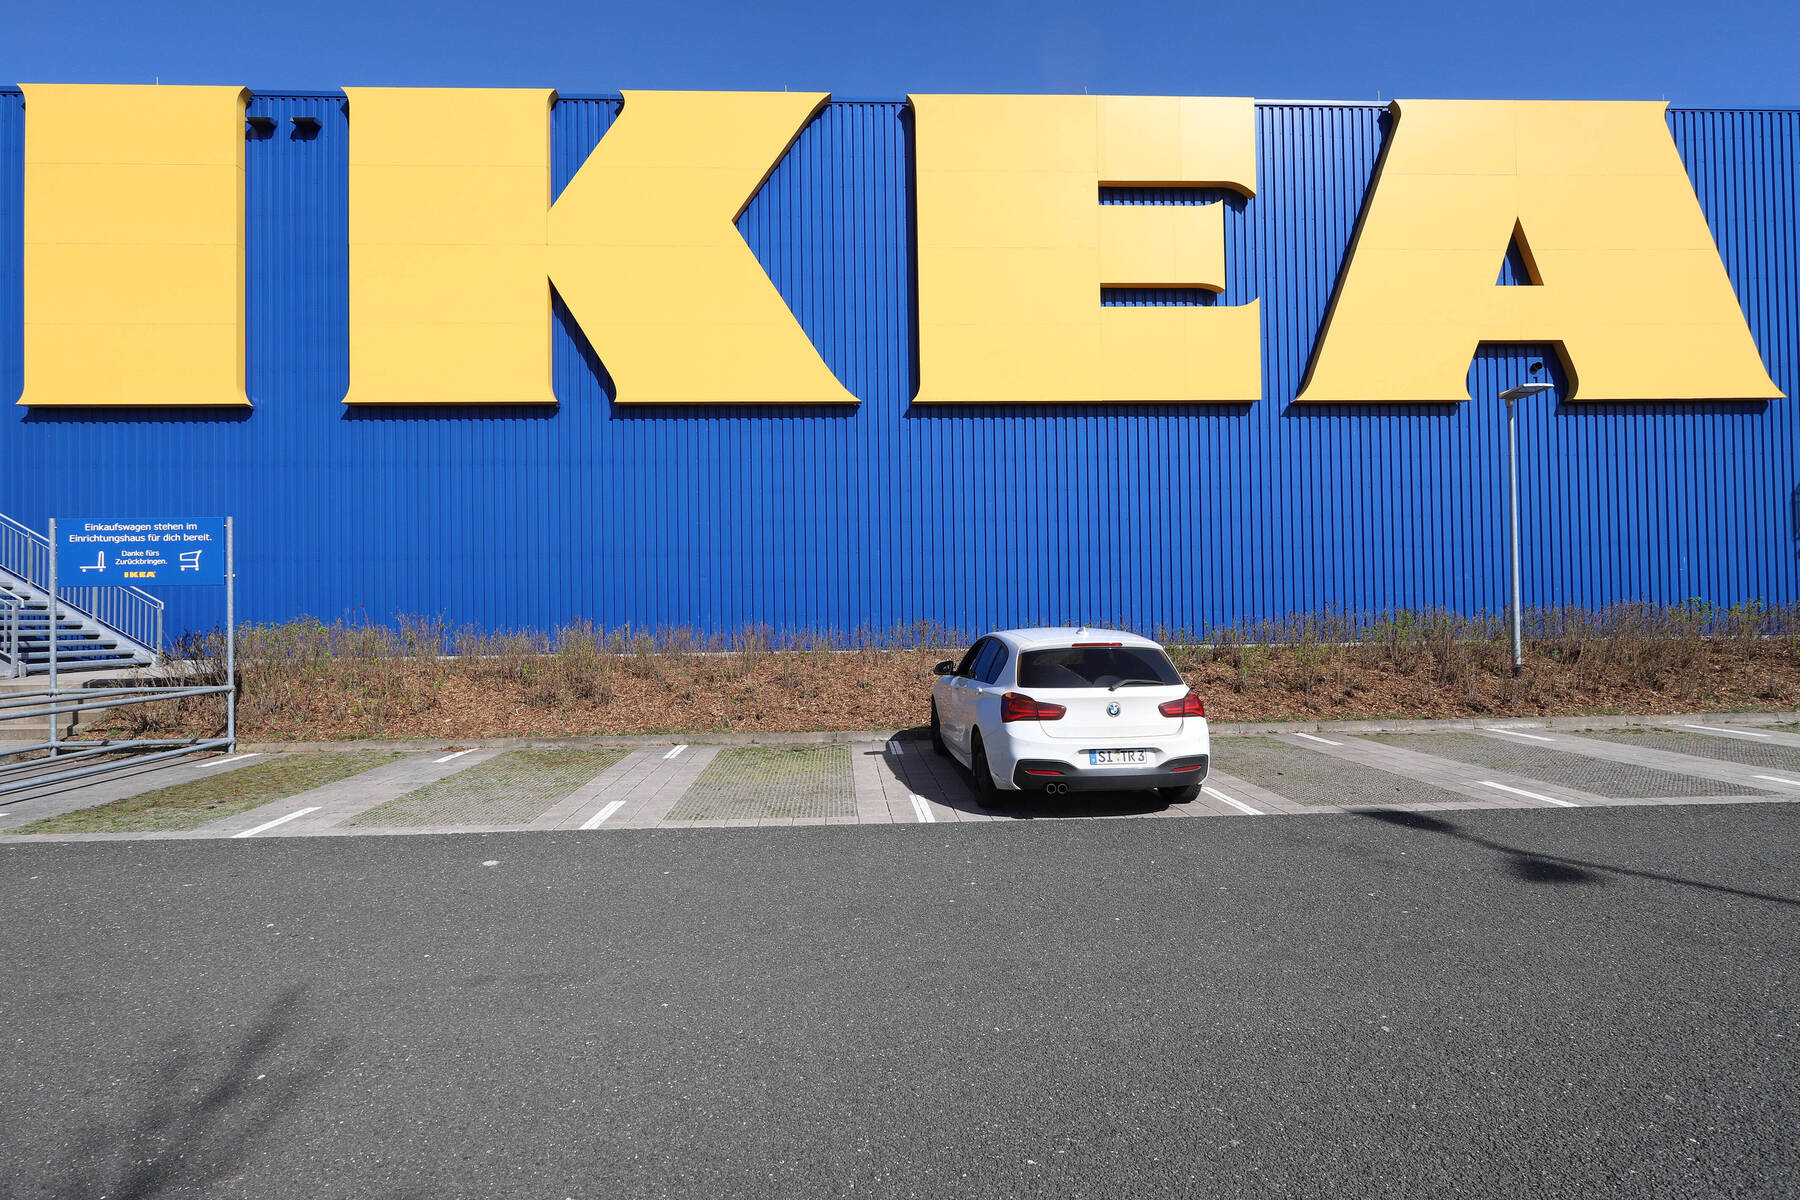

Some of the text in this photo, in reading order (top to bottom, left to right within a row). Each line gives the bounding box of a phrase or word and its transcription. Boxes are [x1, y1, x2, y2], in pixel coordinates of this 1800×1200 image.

[16, 83, 1786, 408] IKEA
[85, 523, 151, 532] Einkaufswagen
[154, 523, 184, 531] stehen
[69, 535, 145, 543] Einrichtungshaus
[148, 534, 160, 542] für
